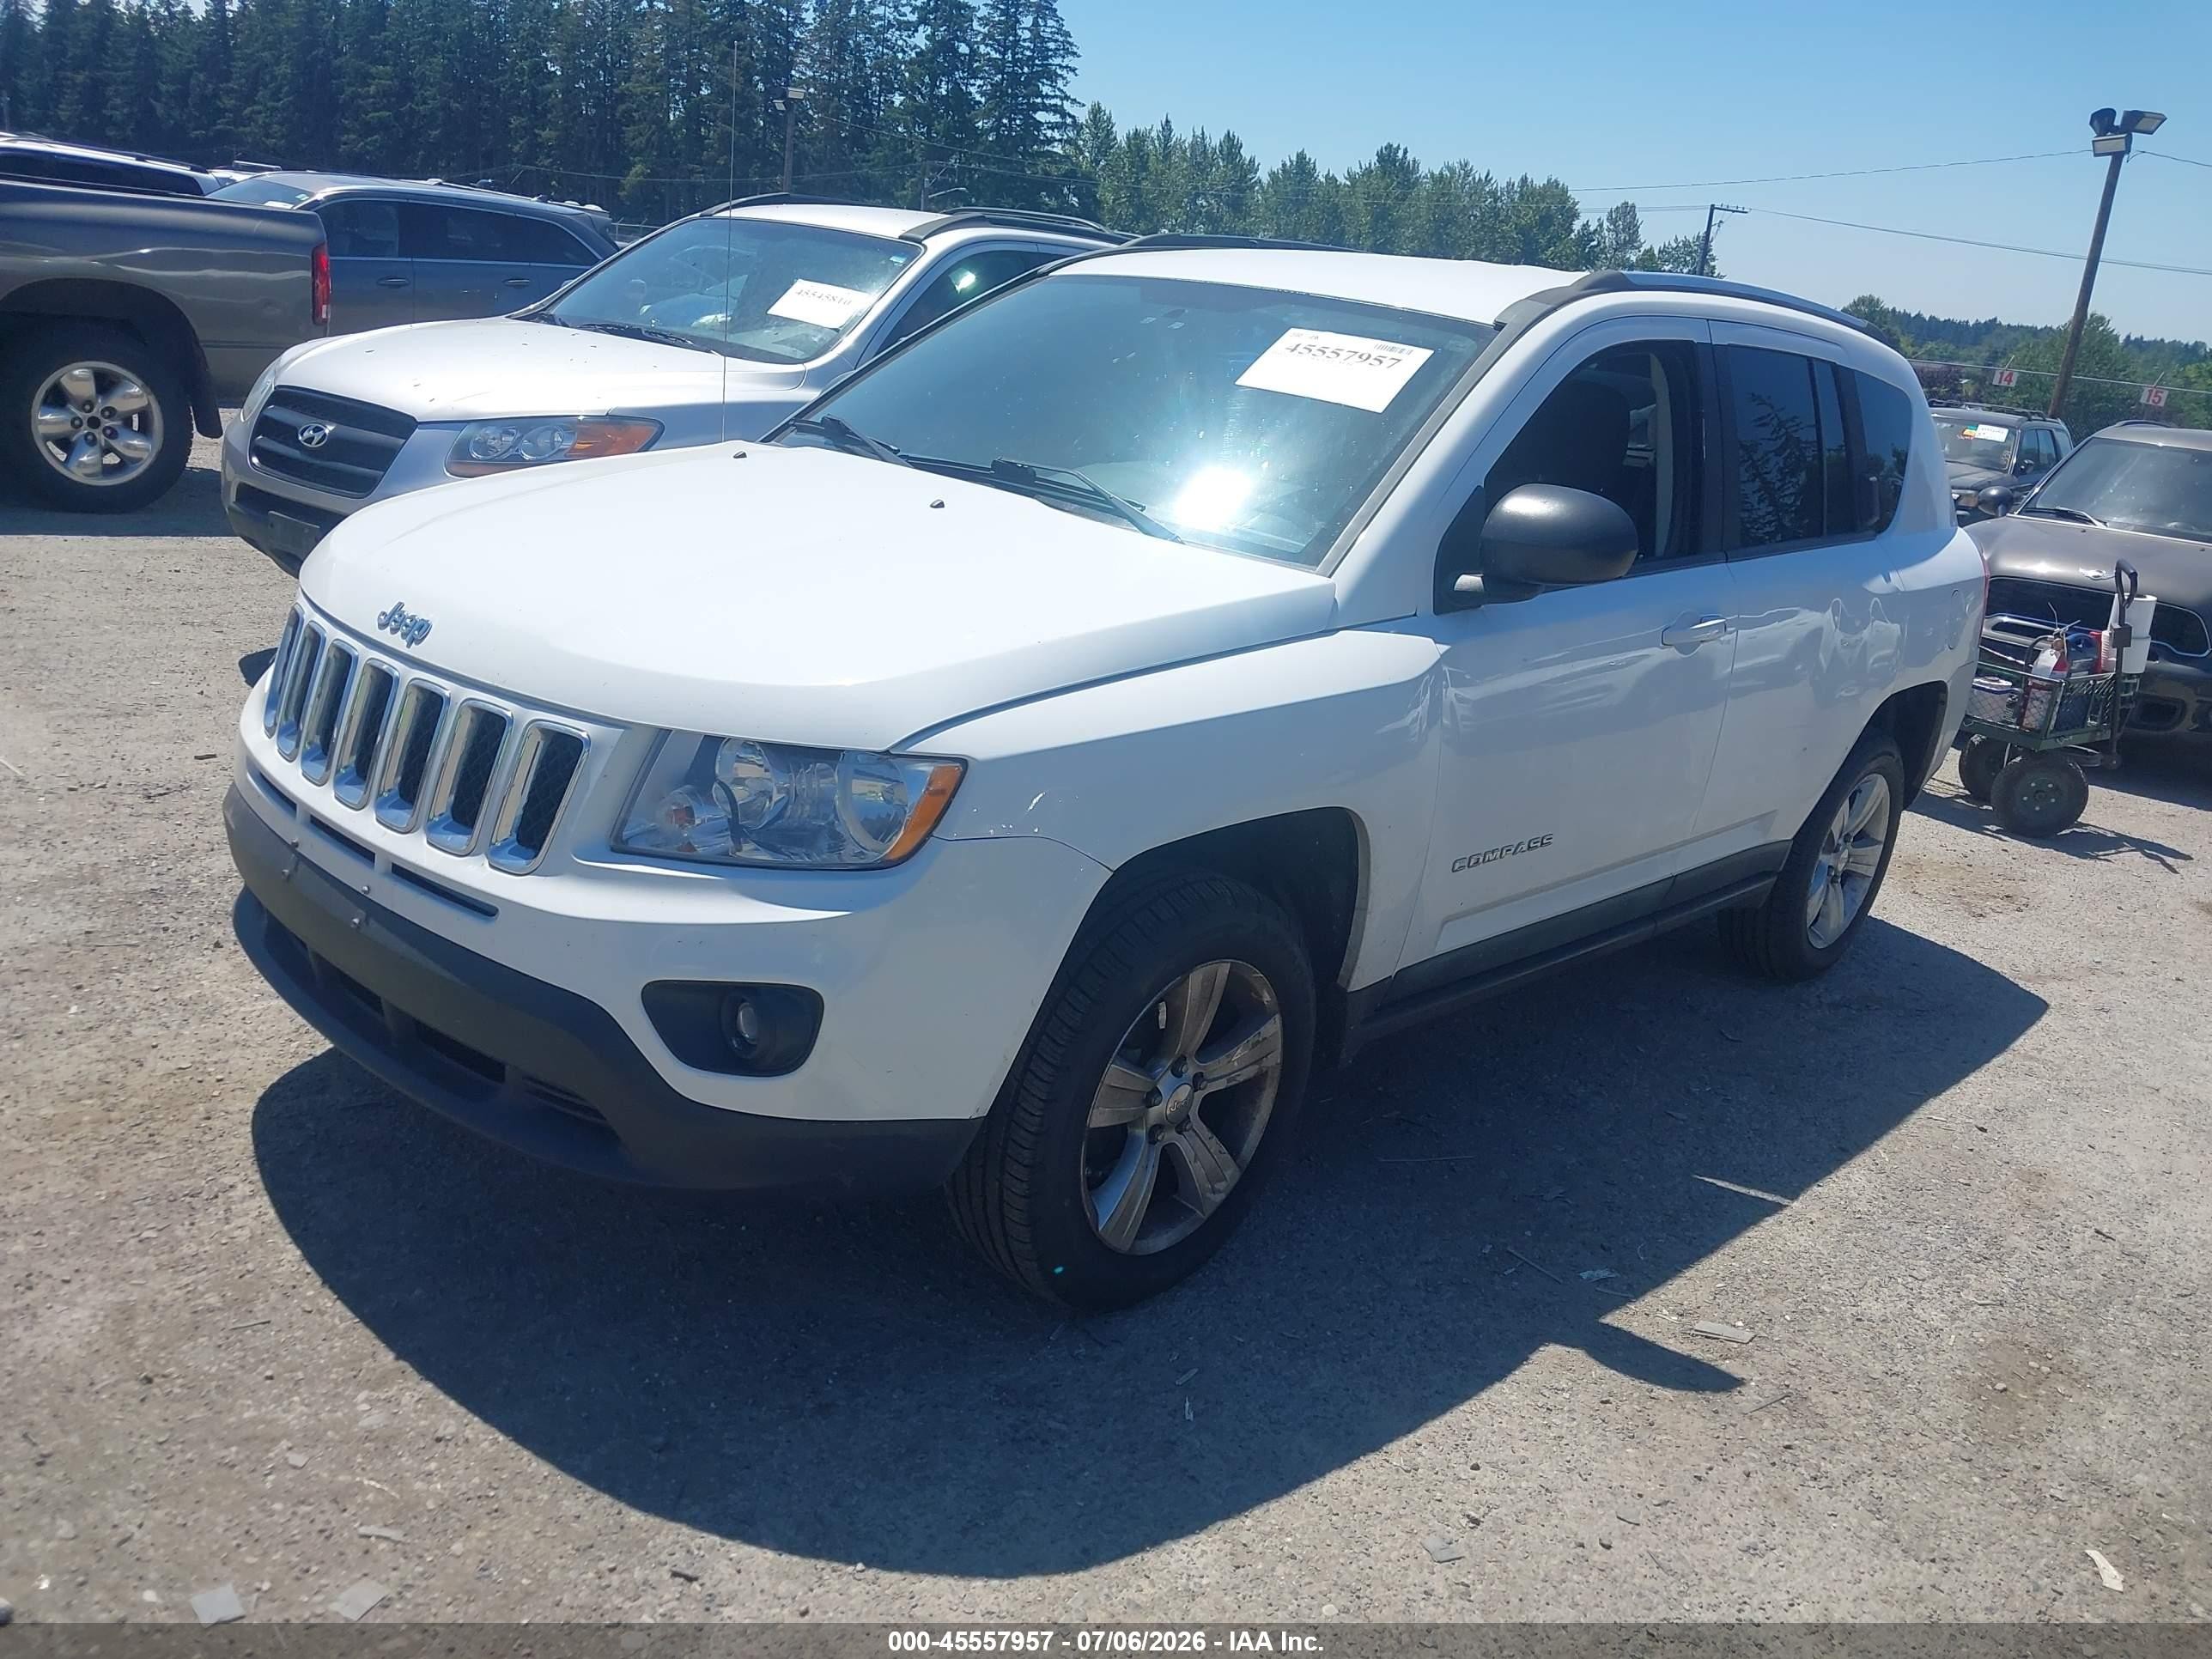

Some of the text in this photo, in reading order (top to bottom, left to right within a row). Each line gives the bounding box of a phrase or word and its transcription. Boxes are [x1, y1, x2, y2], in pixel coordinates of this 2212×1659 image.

[1285, 343, 1402, 369] 45557957
[1998, 371, 2014, 386] 14
[2146, 389, 2164, 404] 15
[377, 601, 433, 649] Jeep
[1451, 834, 1553, 872] COMPASS
